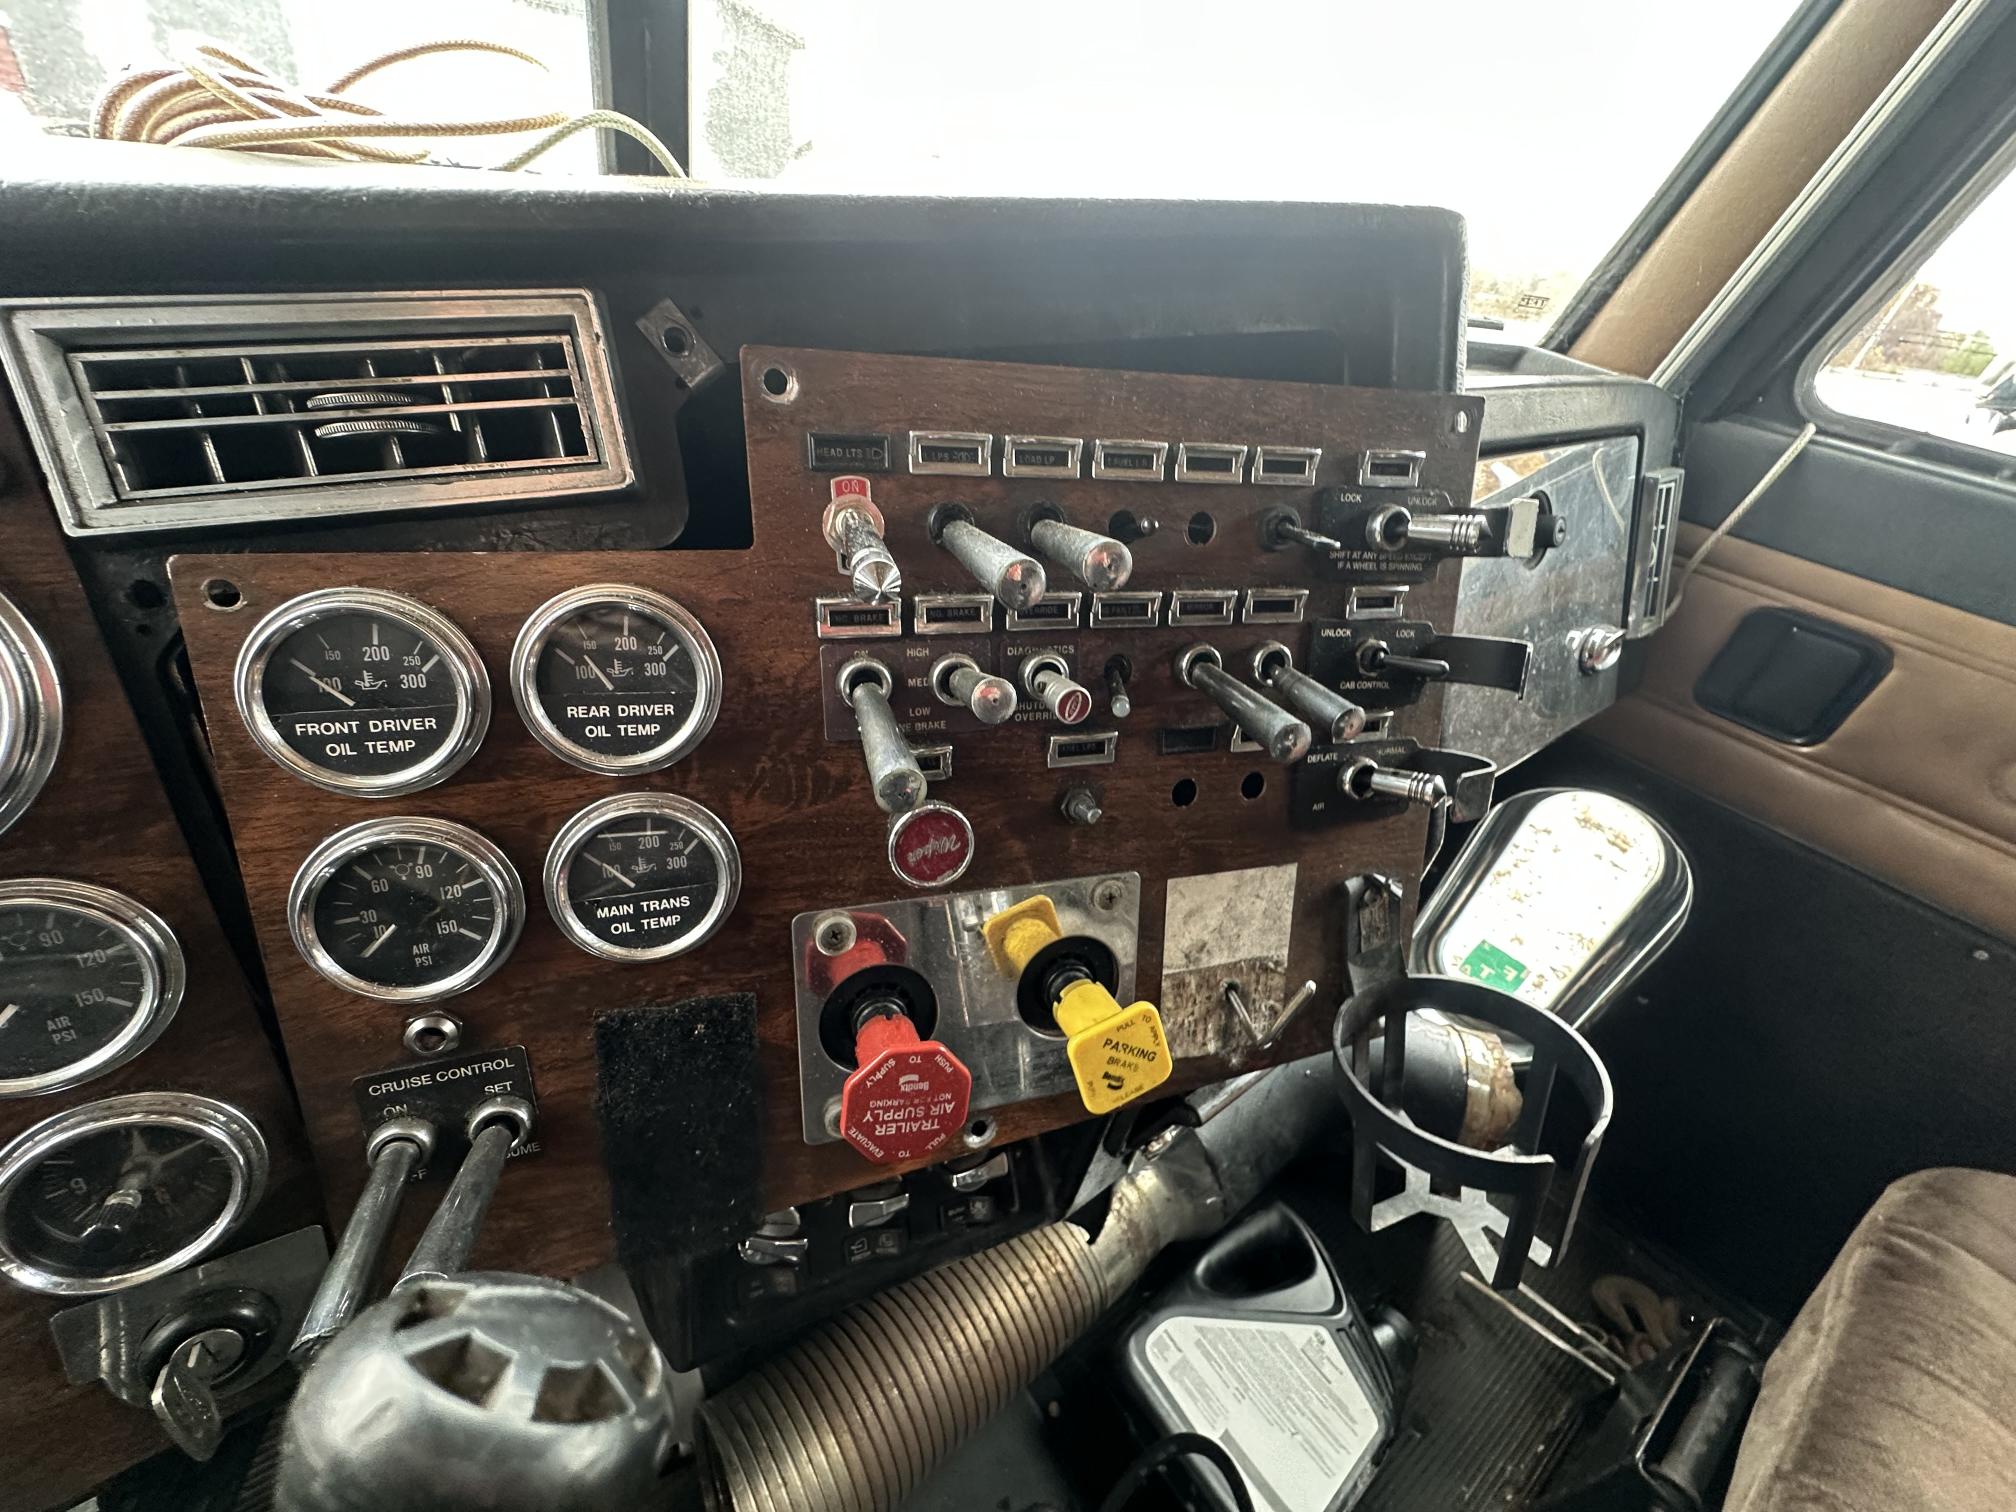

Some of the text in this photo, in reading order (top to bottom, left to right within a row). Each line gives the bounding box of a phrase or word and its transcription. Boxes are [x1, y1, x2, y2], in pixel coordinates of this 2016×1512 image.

[841, 479, 859, 493] ON
[1340, 492, 1362, 503] LOCK
[1352, 550, 1361, 559] AT
[1362, 550, 1378, 560] ANY
[1353, 561, 1377, 570] WHEEL
[1321, 628, 1352, 638] UNLOCK
[1396, 629, 1415, 638] LOCK
[583, 640, 597, 650] 150
[614, 636, 637, 651] 200
[648, 645, 662, 655] 250
[325, 650, 341, 661] 150
[362, 646, 390, 661] 200
[906, 647, 929, 657] HIGH
[403, 655, 421, 667] 250
[575, 665, 597, 680] 100
[644, 662, 666, 676] 300
[400, 673, 427, 689] 300
[1340, 681, 1390, 690] CAB CONTROL
[567, 704, 674, 718] REAR DRIVER
[909, 707, 931, 717] LOW
[295, 717, 437, 736] FRONT DRIVER
[585, 724, 660, 738] OIL TEMP
[914, 720, 947, 731] BRAKE
[326, 739, 416, 756] OIL TEMP
[1307, 752, 1338, 764] DEFLATE
[1312, 802, 1325, 812] AIR
[609, 842, 622, 852] 150
[638, 835, 660, 850] 200
[669, 841, 684, 851] 250
[666, 856, 688, 870] 300
[415, 864, 432, 879] 90
[371, 878, 388, 893] 60
[440, 884, 462, 901] 120
[596, 895, 690, 919] MAIN TRANS
[360, 909, 377, 923] 30
[437, 920, 458, 935] 150
[611, 915, 681, 935] OIL TEMP
[38, 930, 64, 947] 90
[412, 943, 430, 955] AIR
[76, 949, 107, 969] 120
[415, 957, 432, 967] PSI
[74, 988, 105, 1008] 150
[47, 1016, 72, 1032] AIR
[1116, 1019, 1135, 1032] PULL
[1142, 1014, 1151, 1023] TO
[52, 1030, 77, 1045] PSI
[1102, 1037, 1157, 1062] PARKING
[368, 1058, 515, 1096] CRUISE CONTROL
[865, 1054, 953, 1088] PUSH TO SUPPLY
[484, 1081, 513, 1094] SET
[934, 1093, 952, 1102] NOT
[383, 1103, 408, 1118] ON
[862, 1101, 955, 1123] AIR SUPPLY
[875, 1118, 940, 1136] TRAILER
[848, 1125, 885, 1158] EVACUATE
[925, 1133, 946, 1150] PULL
[69, 1177, 87, 1194] 9
